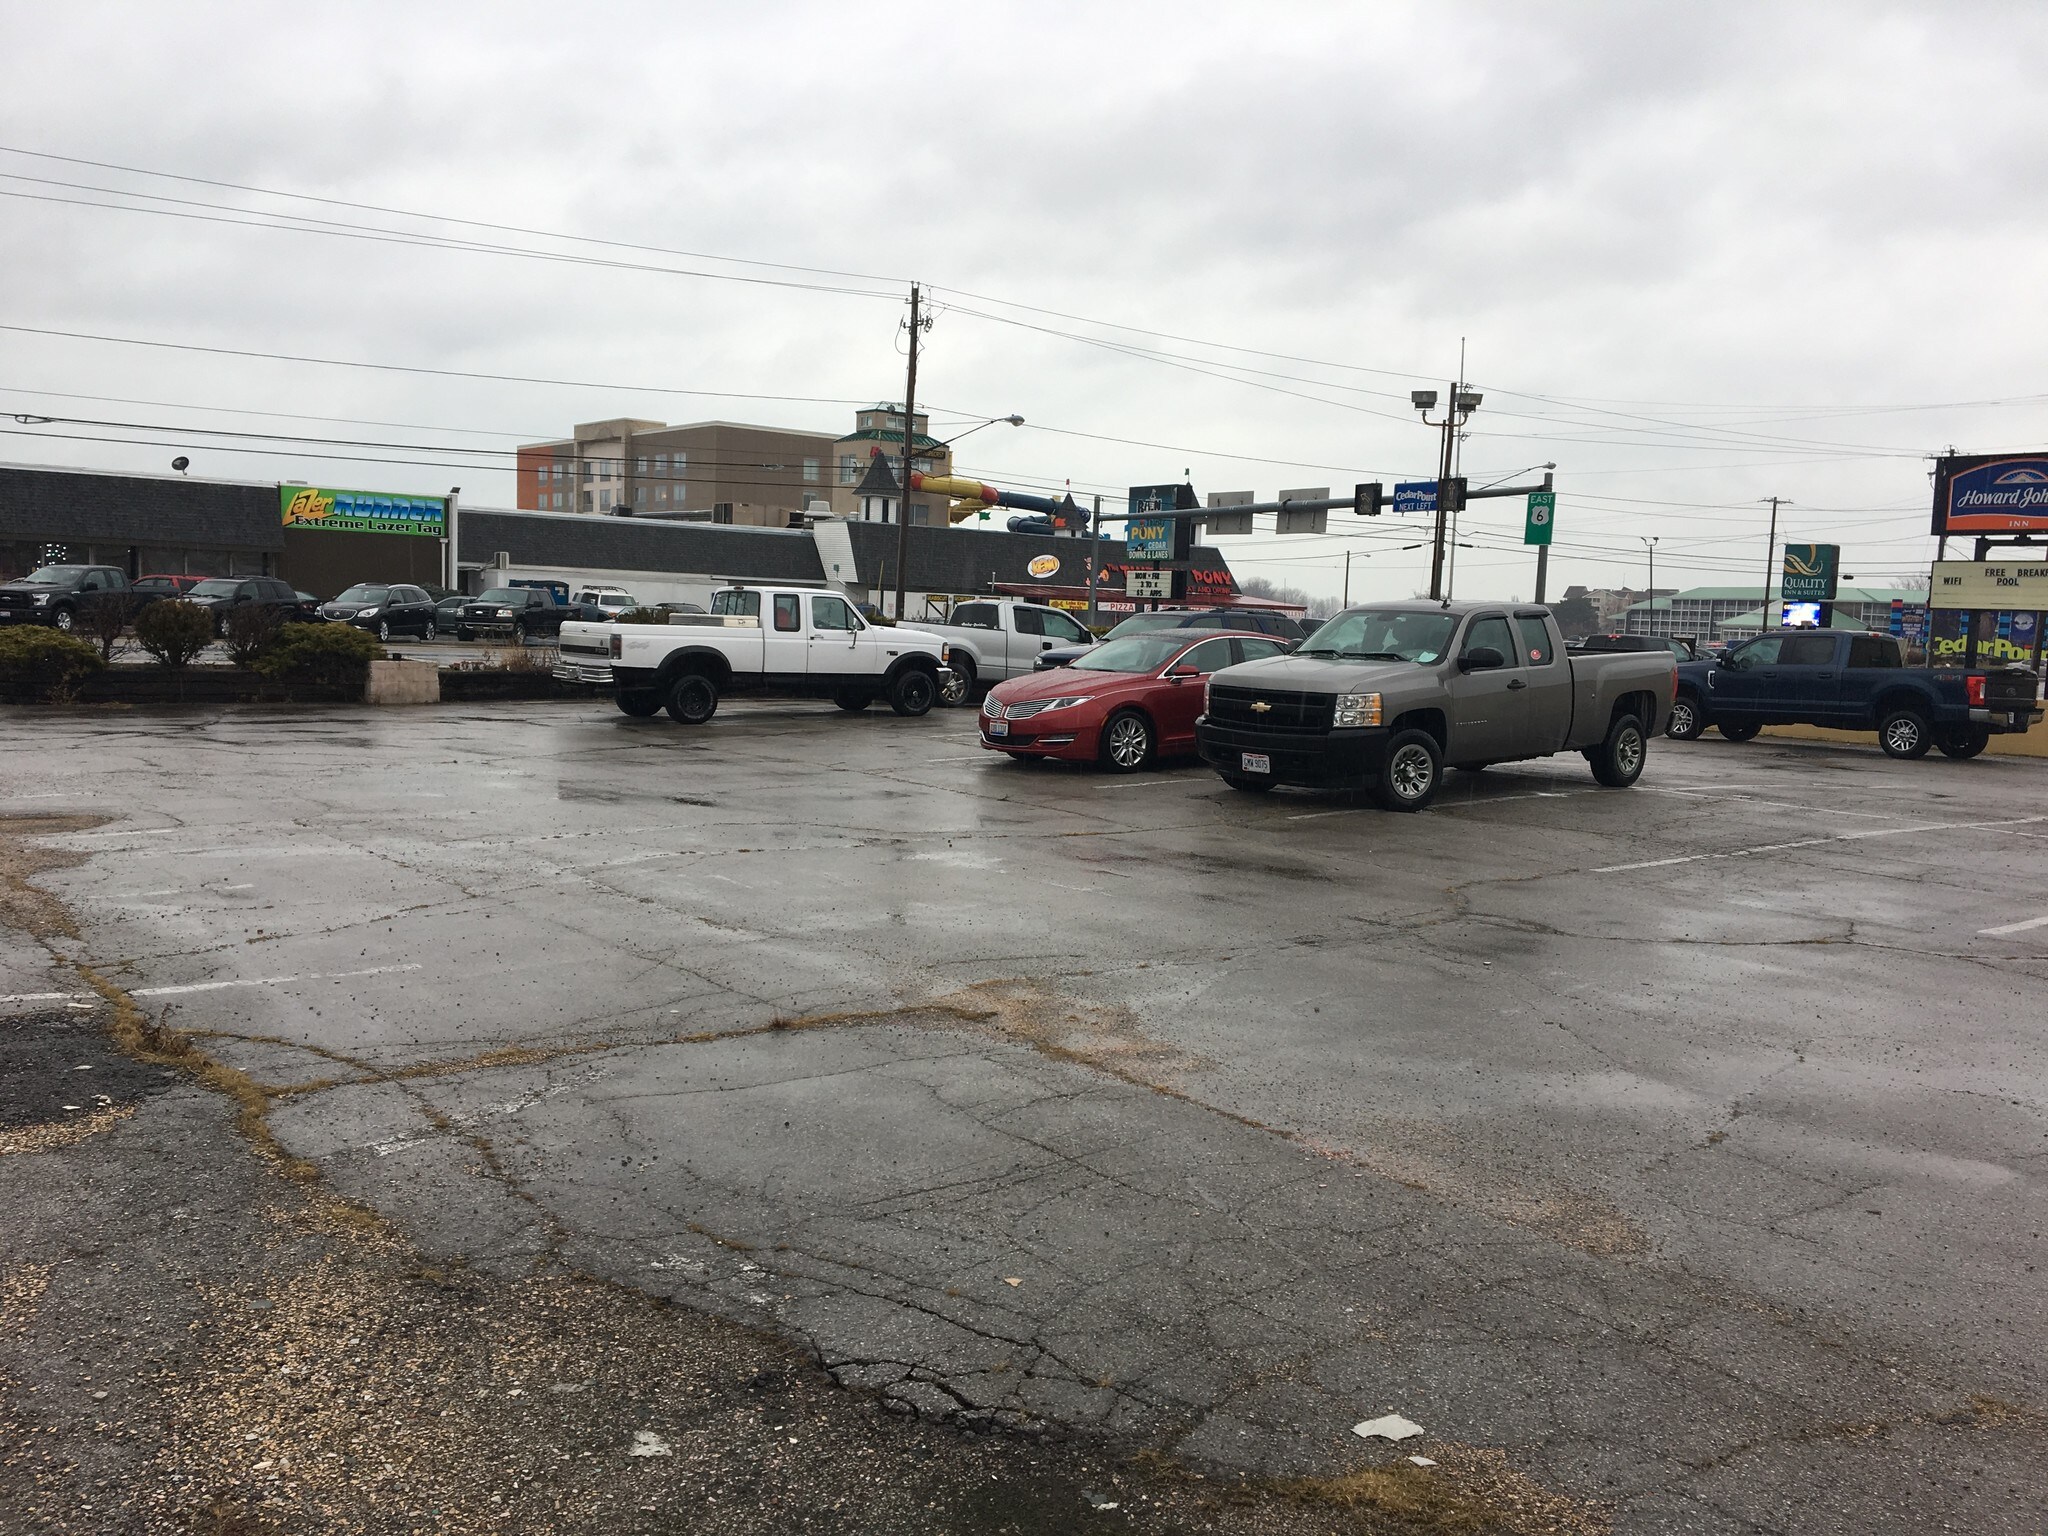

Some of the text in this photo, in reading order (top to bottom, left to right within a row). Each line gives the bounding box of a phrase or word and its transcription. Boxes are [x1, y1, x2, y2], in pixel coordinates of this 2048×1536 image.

[1530, 495, 1553, 504] EAST
[1957, 489, 2020, 507] Howard
[1399, 502, 1431, 511] NEXT LEFT
[1536, 510, 1544, 521] 6
[294, 515, 442, 536] Extreme Lazer Tag
[1131, 526, 1165, 540] PONY
[1147, 541, 1167, 549] CEDAR
[1152, 550, 1169, 559] LANES
[1191, 569, 1232, 585] PONY
[1985, 568, 2006, 577] FREE
[1784, 577, 1827, 589] QUALITY
[1943, 577, 2019, 586] WIFI POOL
[1110, 603, 1134, 611] PIZZA
